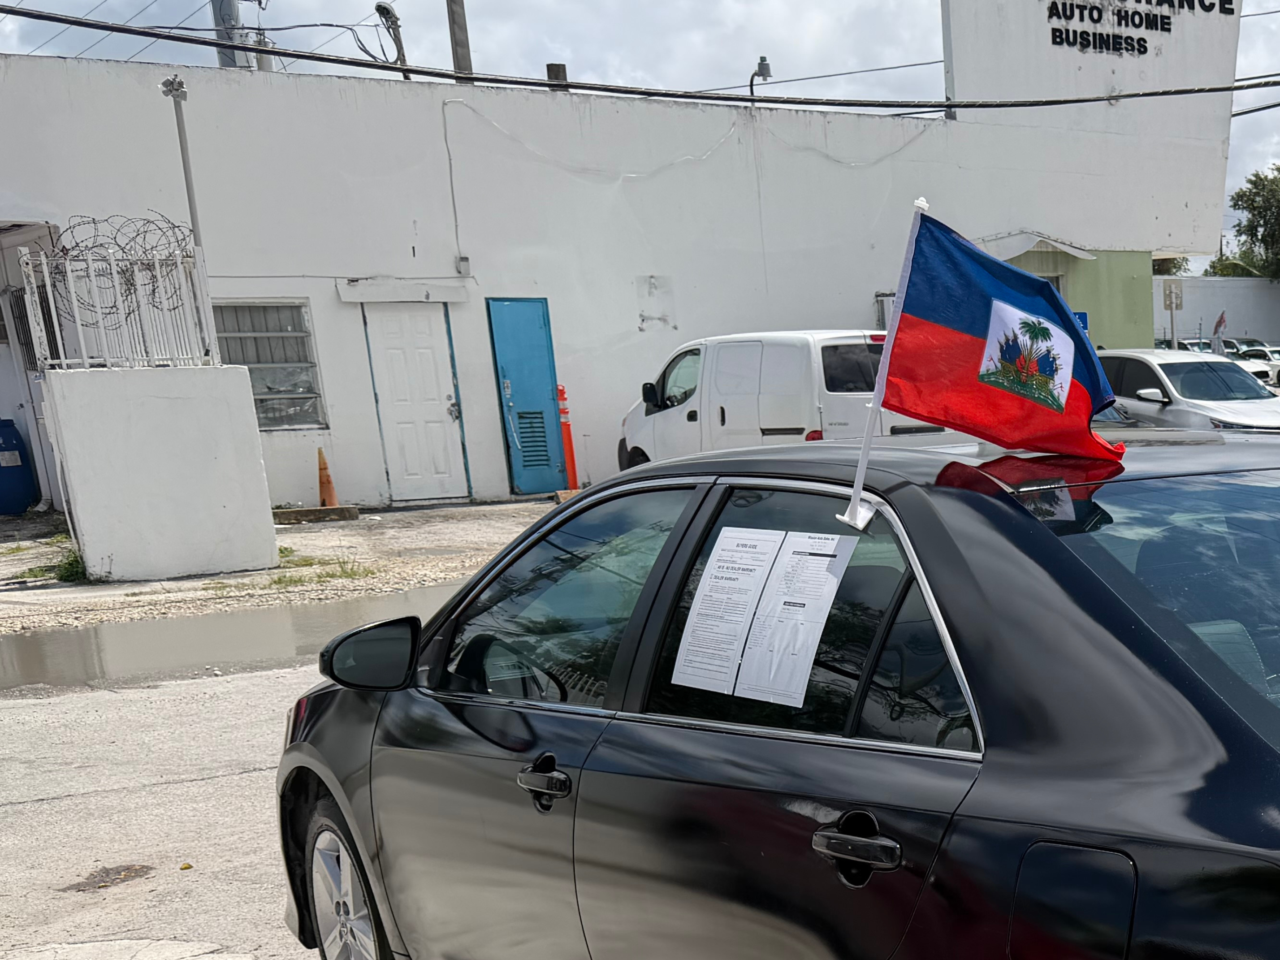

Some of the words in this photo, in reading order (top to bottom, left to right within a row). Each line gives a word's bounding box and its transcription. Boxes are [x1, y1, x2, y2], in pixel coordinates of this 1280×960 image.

[1049, 2, 1103, 24] AUTO
[1116, 9, 1172, 32] HOME
[1051, 27, 1148, 55] BUSINESS
